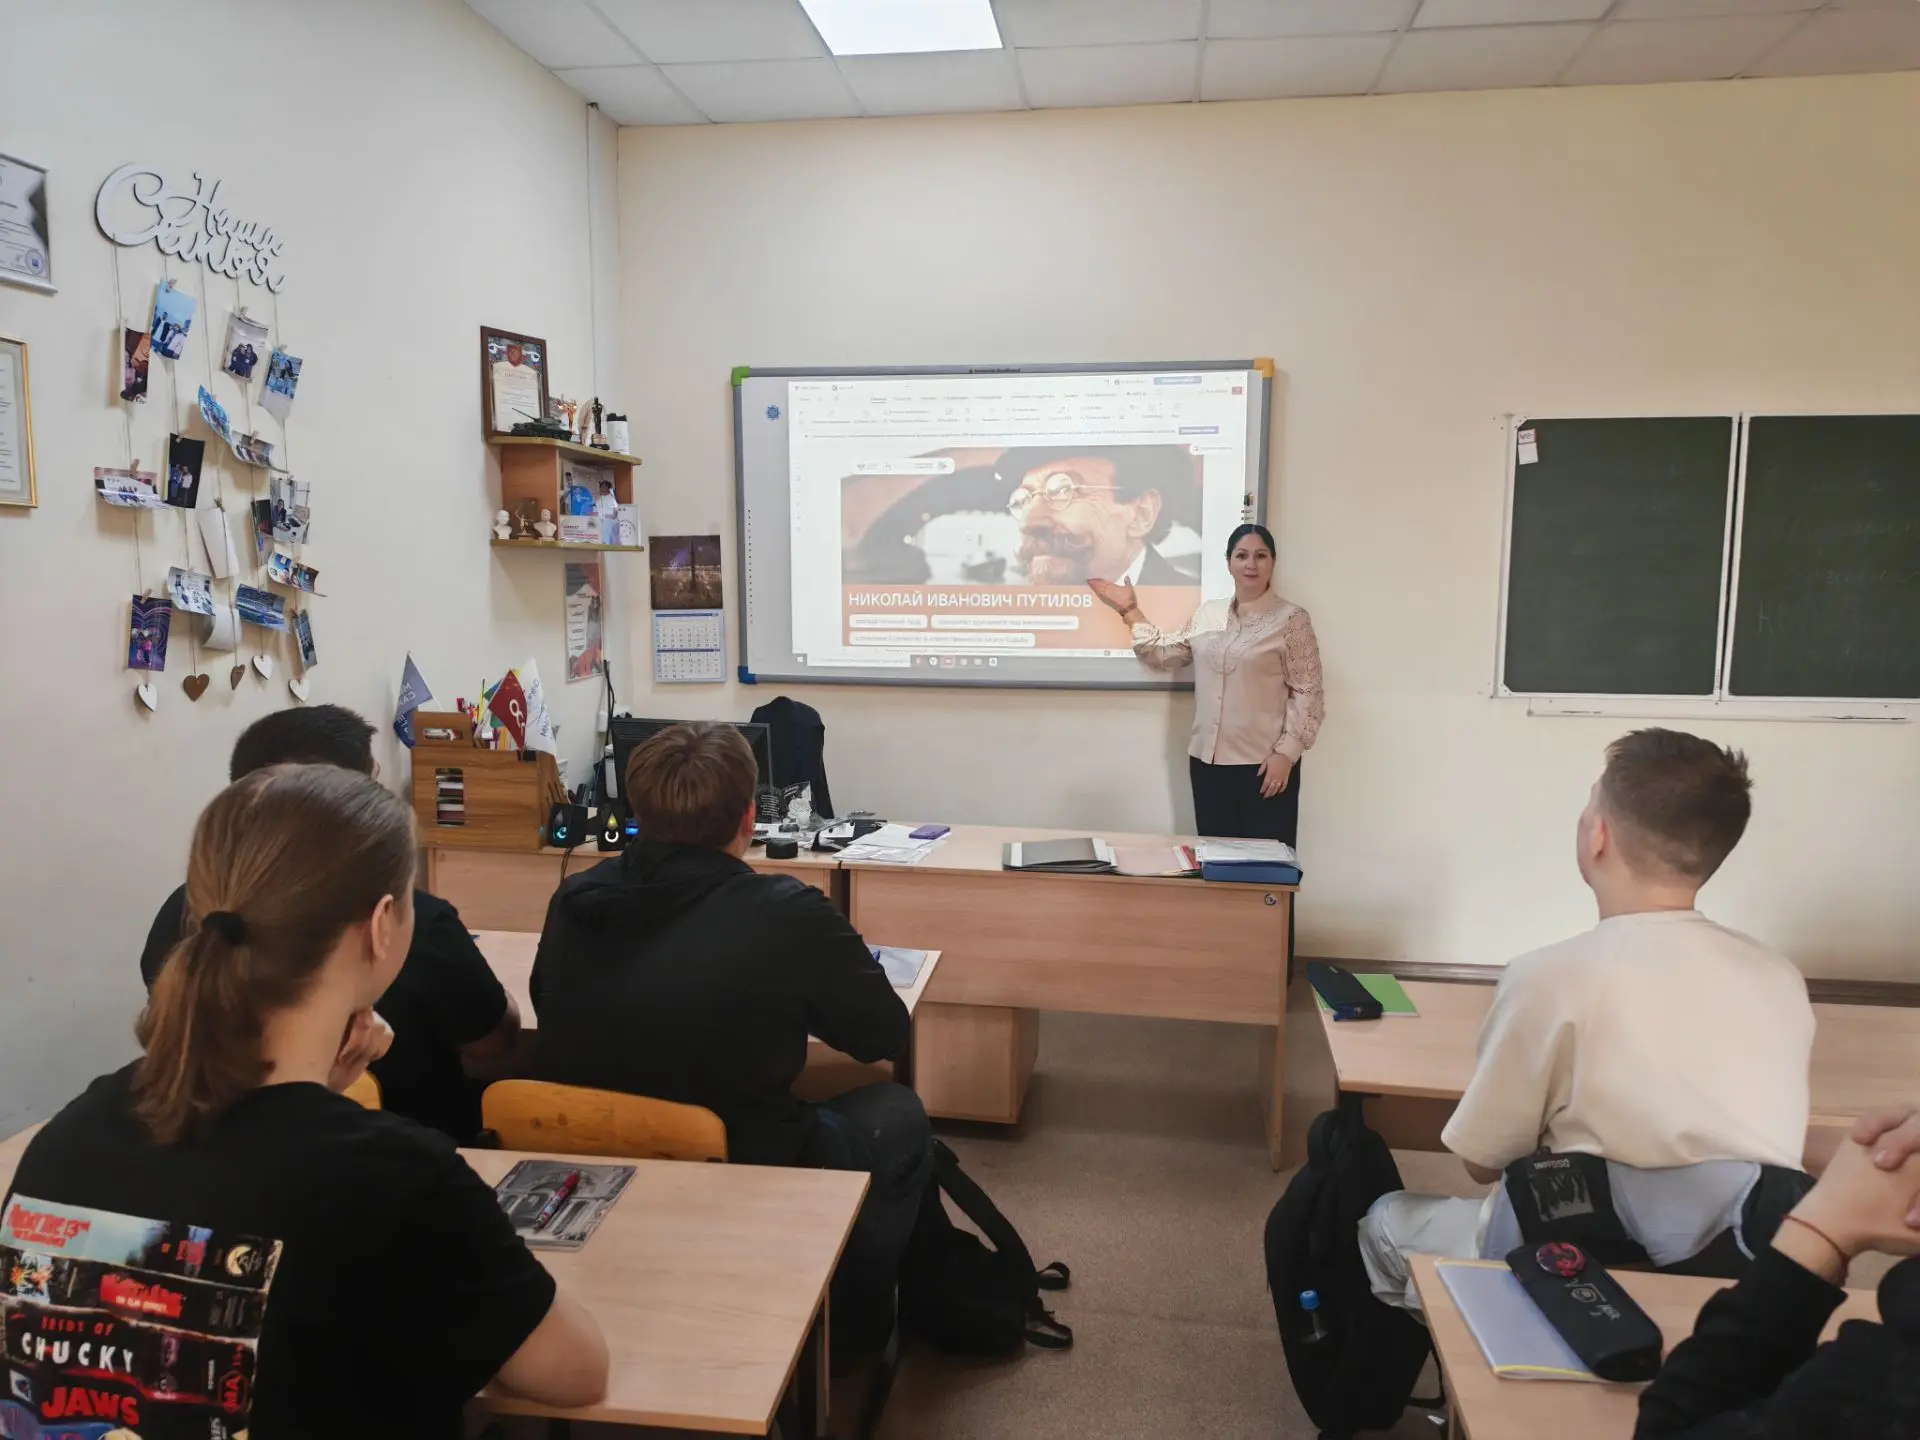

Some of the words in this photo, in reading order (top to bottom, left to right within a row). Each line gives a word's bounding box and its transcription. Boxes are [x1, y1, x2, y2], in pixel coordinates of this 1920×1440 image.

[848, 591, 924, 608] НИКОЛАЙ
[927, 593, 1012, 608] ИВАНОВИЧ
[1016, 593, 1093, 608] ПУТИЛОВ
[21, 1331, 134, 1375] CHUCKY
[41, 1385, 140, 1426] JAWS
